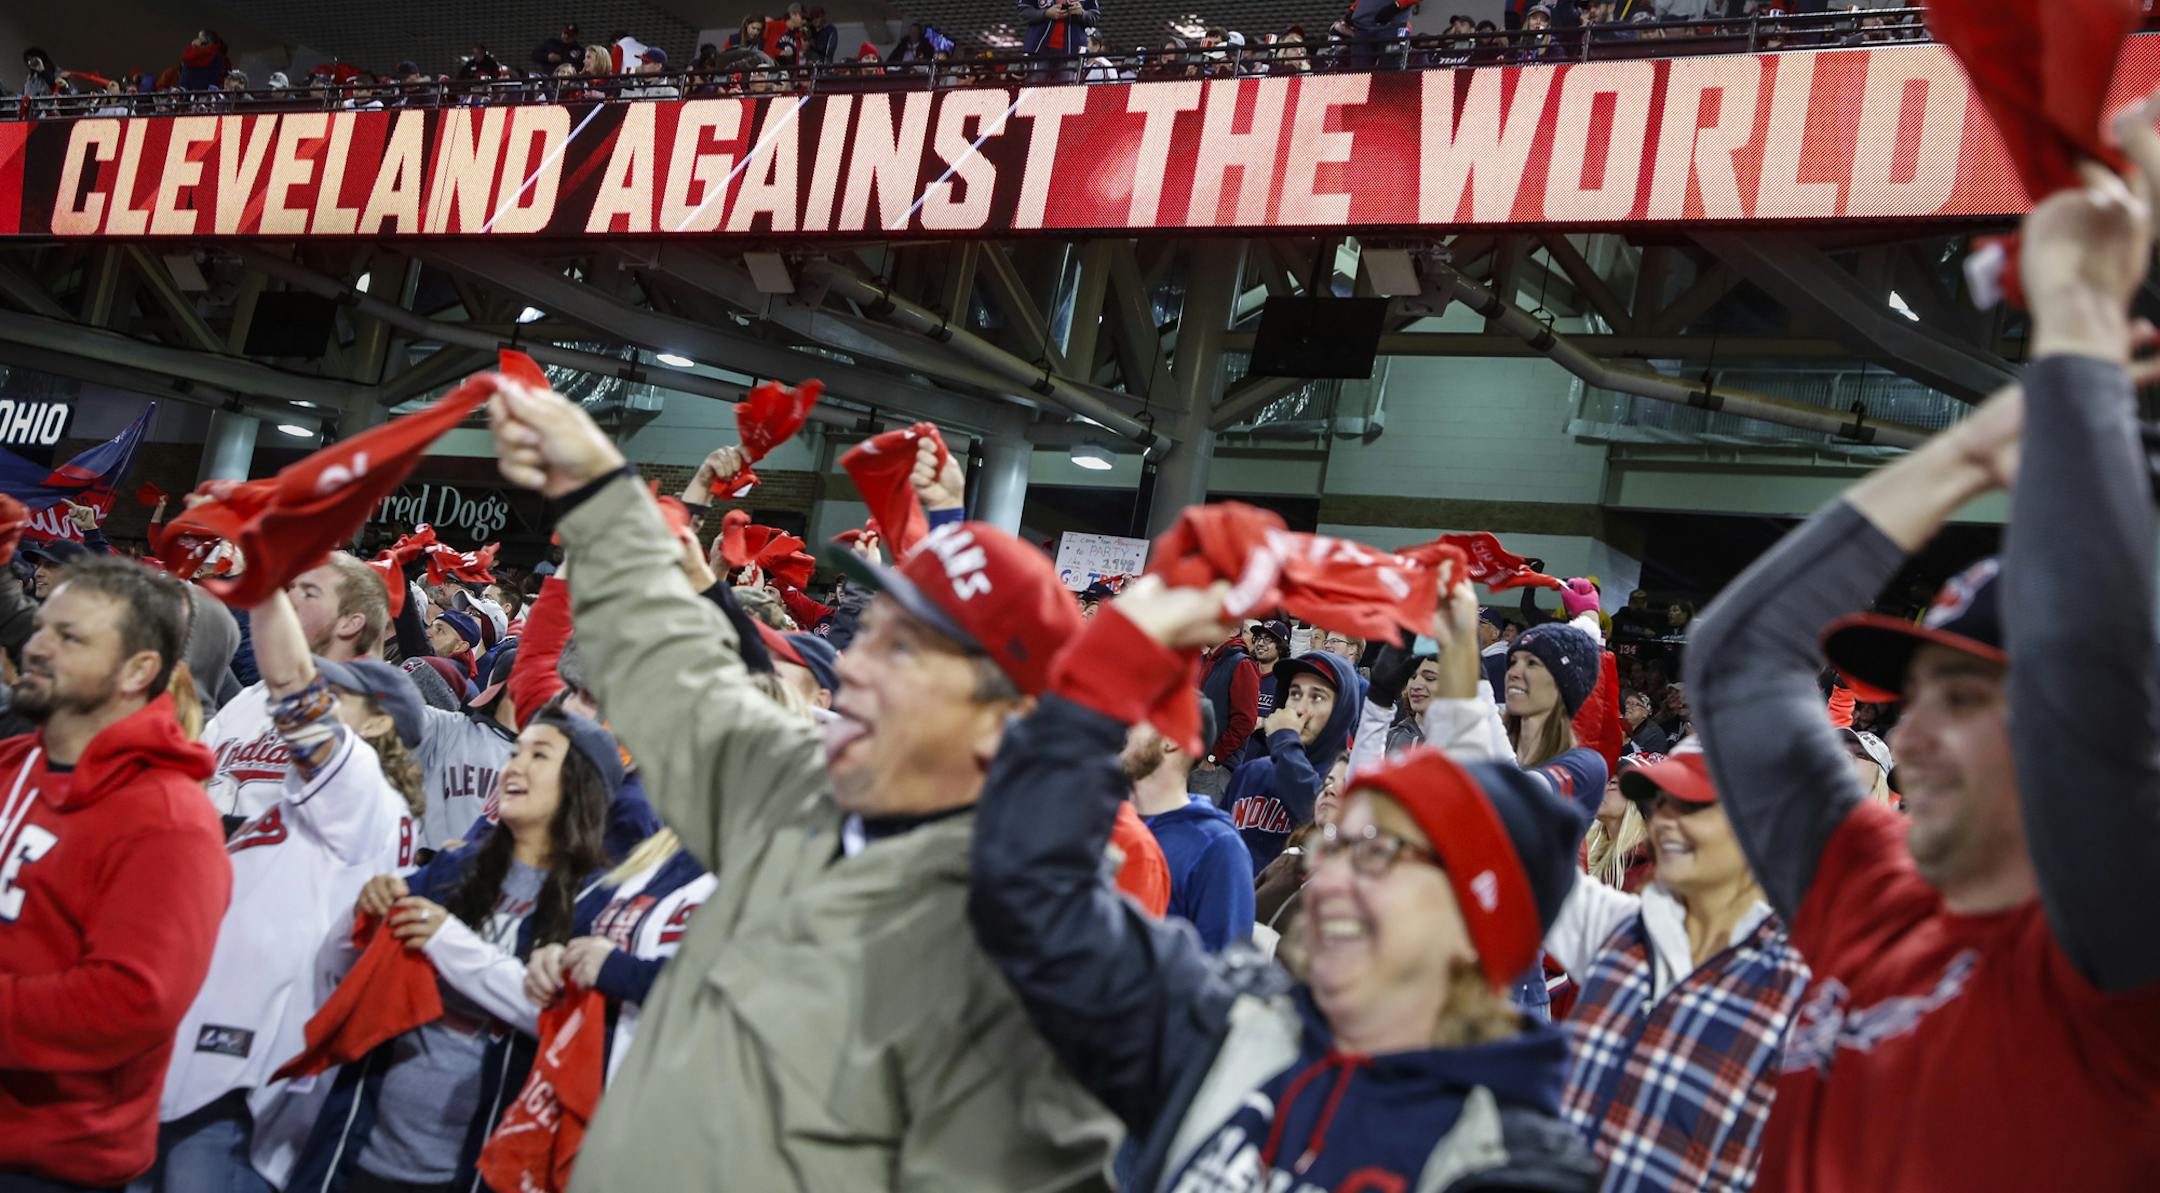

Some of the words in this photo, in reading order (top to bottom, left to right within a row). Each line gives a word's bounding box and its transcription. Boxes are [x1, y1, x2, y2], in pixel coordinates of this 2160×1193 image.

[52, 104, 571, 236] CLEVELAND
[585, 85, 1088, 233] AGAINST
[1125, 73, 1372, 229] THE
[1419, 45, 1968, 224] WORLD
[367, 484, 430, 525] red
[433, 485, 509, 542] Dogs
[1090, 545, 1130, 558] PARTY
[1620, 644, 1638, 655] 134
[1231, 796, 1292, 833] NDIA
